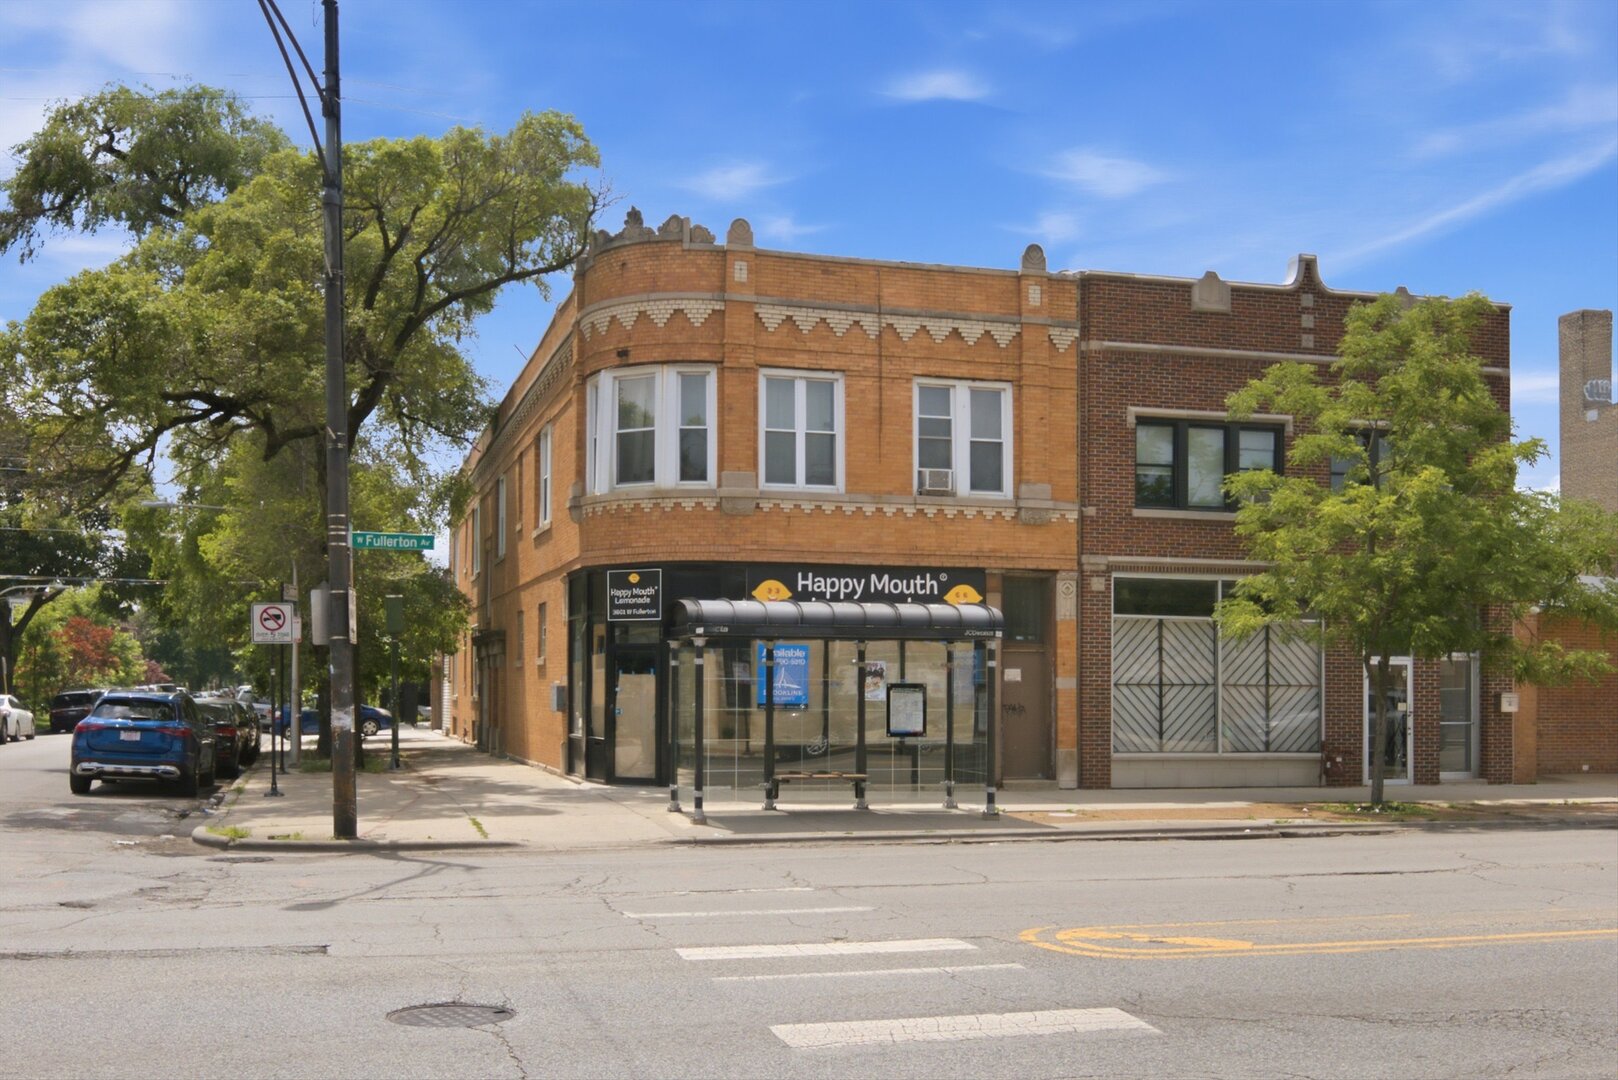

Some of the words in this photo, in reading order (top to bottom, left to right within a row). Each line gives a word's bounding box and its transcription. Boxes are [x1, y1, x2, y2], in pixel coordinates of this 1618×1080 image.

[365, 534, 418, 548] Fullerton
[797, 572, 865, 599] Happy
[610, 588, 632, 598] Happy
[614, 596, 651, 604] Lemonade
